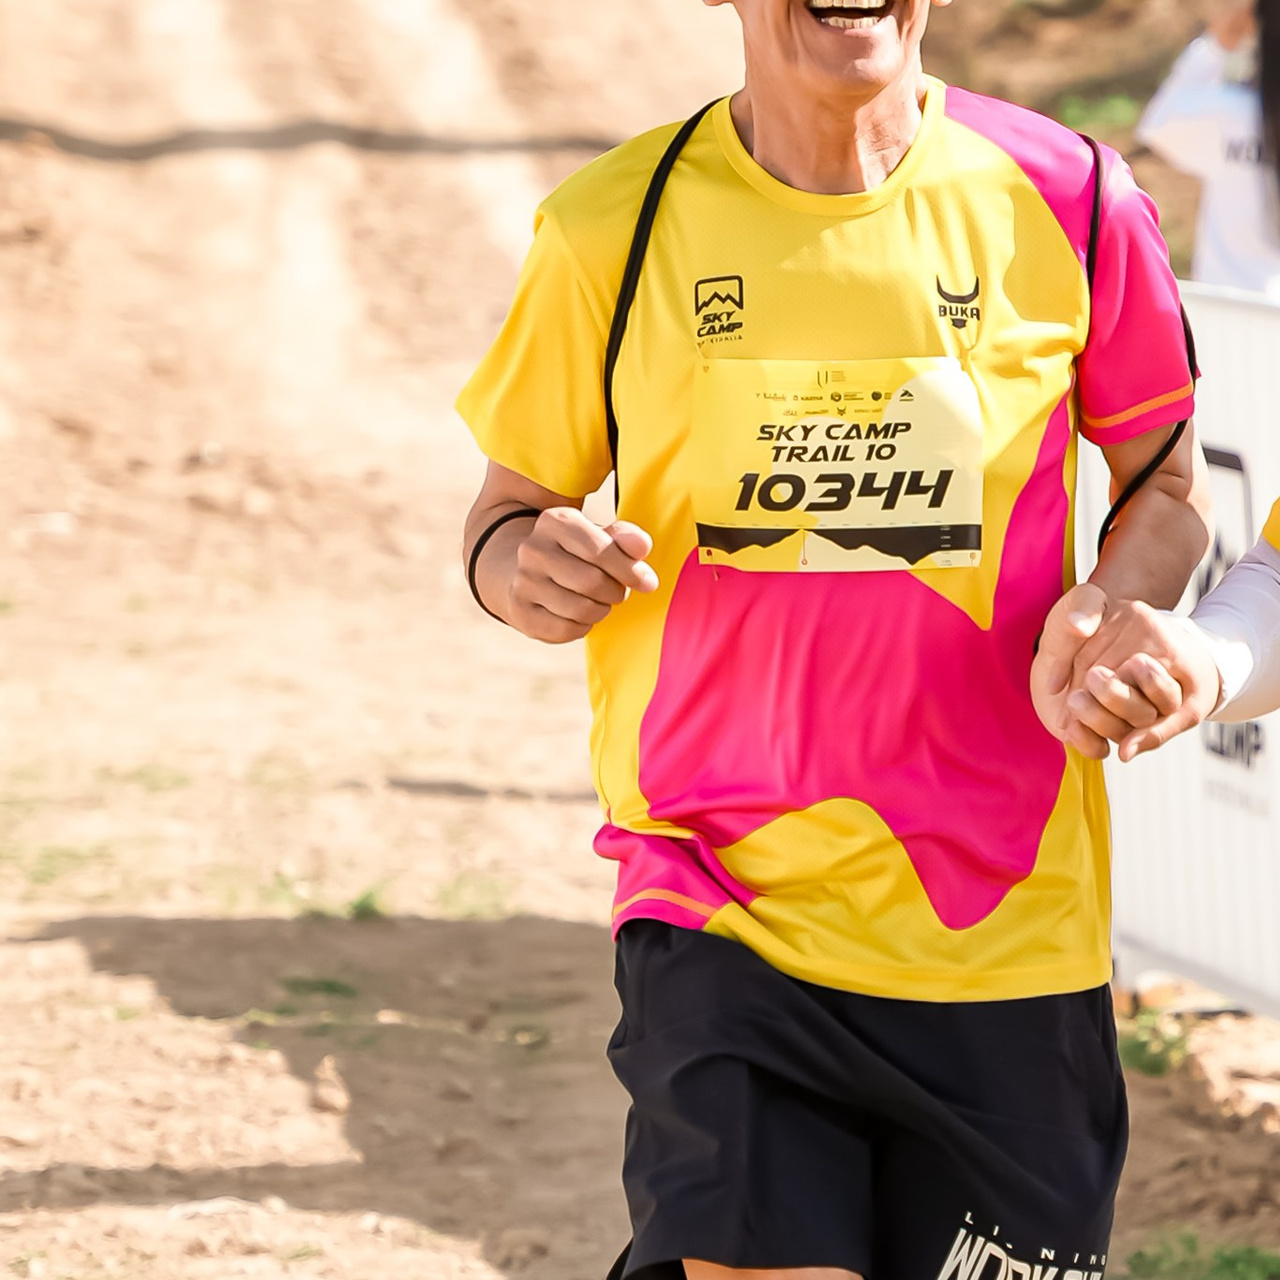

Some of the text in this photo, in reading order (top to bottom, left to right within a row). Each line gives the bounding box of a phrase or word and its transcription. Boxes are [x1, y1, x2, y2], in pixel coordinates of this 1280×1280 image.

[701, 310, 736, 325] SKY
[938, 305, 980, 320] BUKA
[697, 322, 743, 337] CAMP
[756, 422, 912, 441] SKY CAMP
[771, 443, 897, 463] TRAIL 10
[734, 469, 954, 512] 10344
